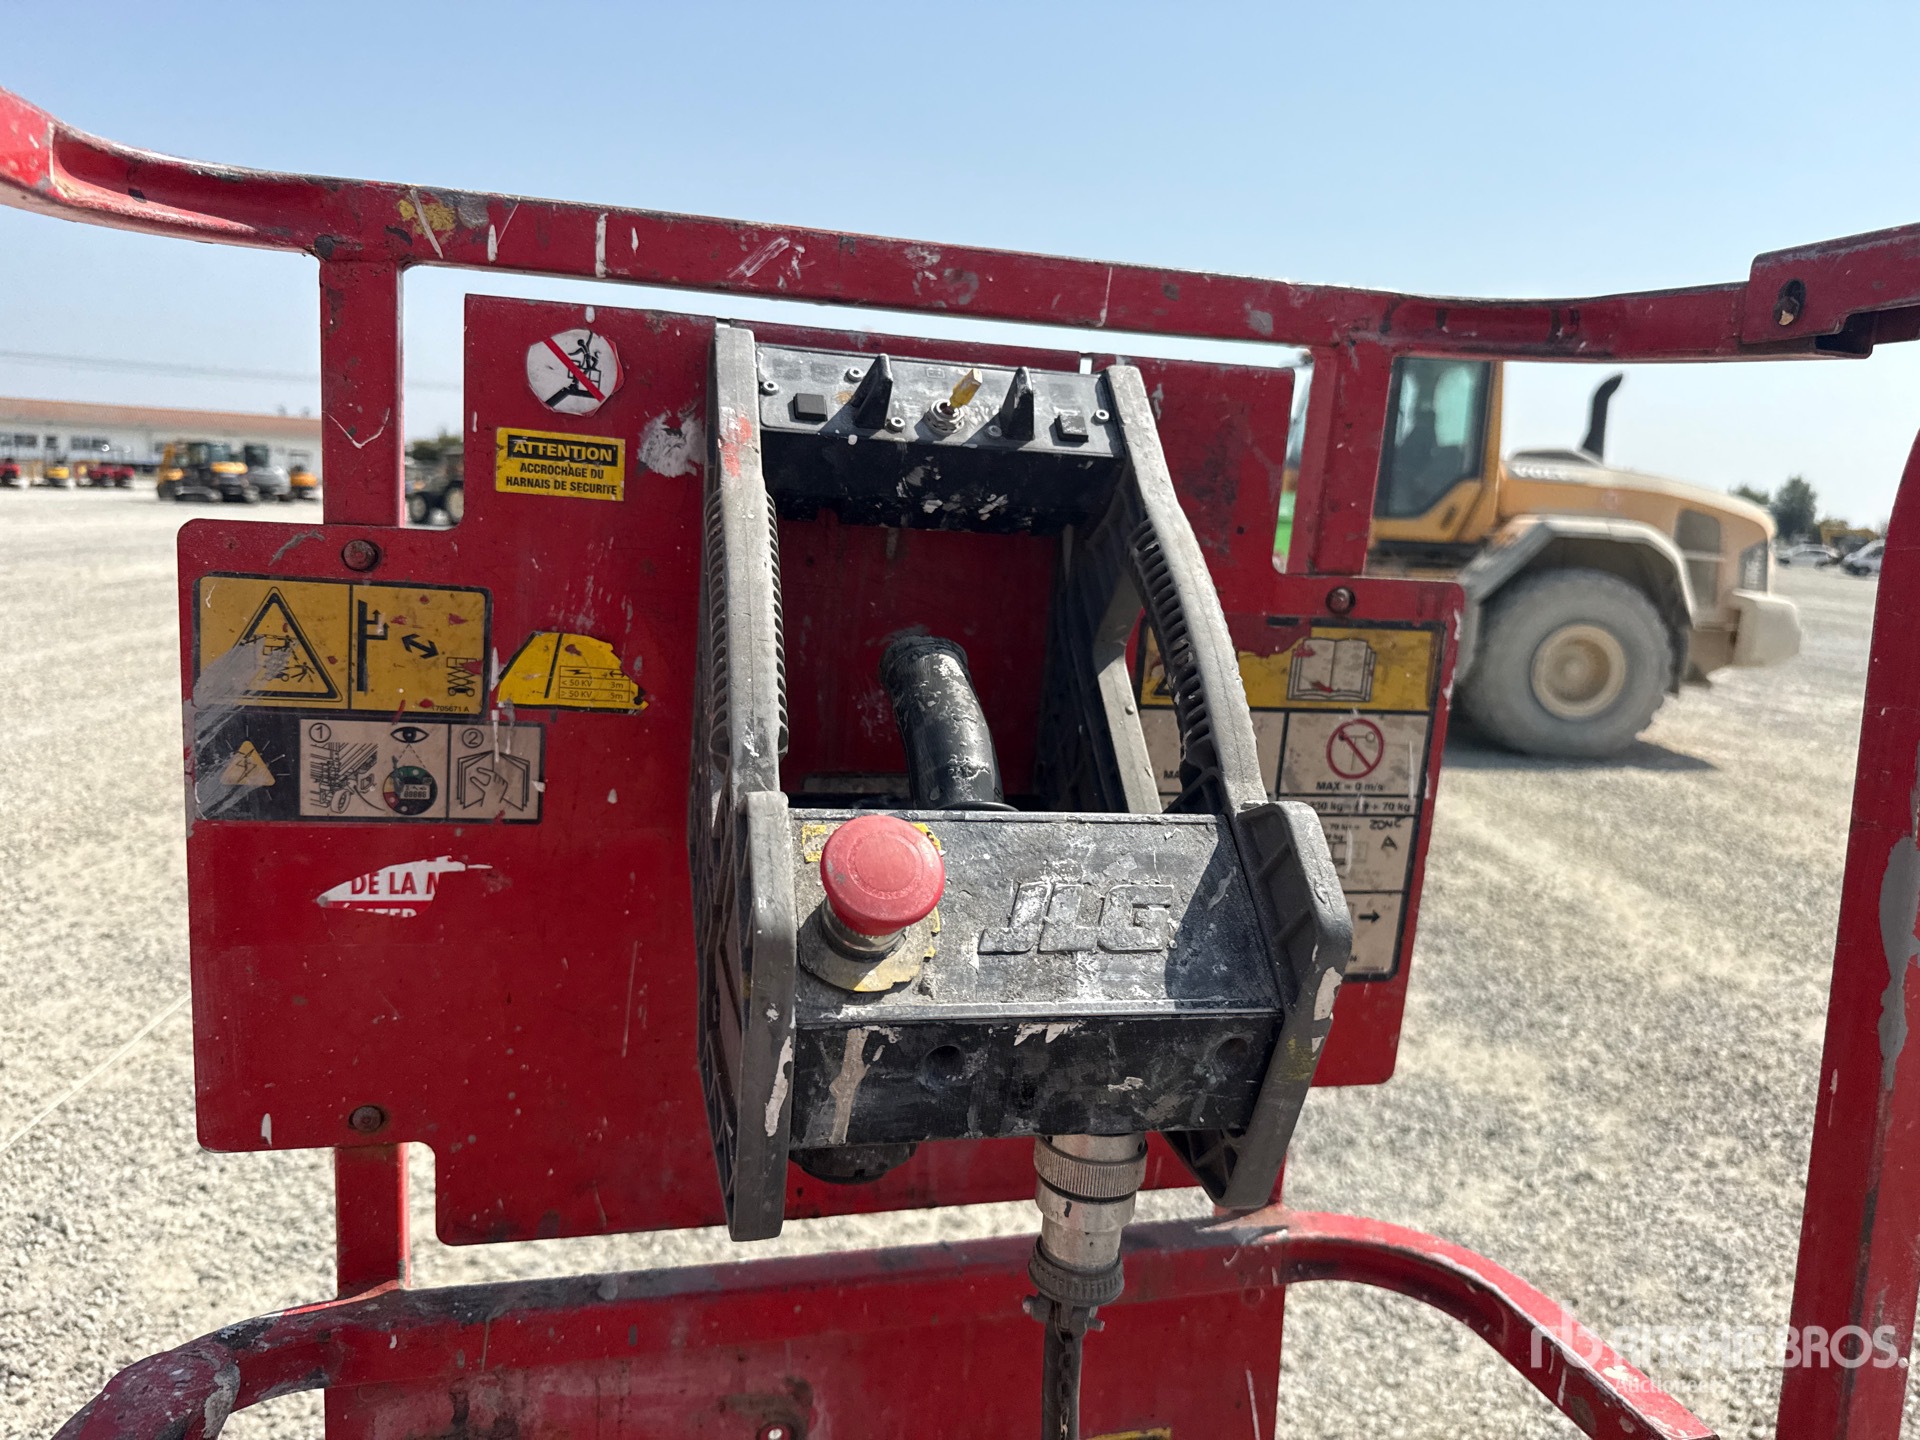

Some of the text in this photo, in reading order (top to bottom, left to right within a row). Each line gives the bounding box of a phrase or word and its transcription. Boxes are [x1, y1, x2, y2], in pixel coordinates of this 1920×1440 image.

[513, 440, 613, 462] ATTENTION
[520, 462, 604, 480] ACCROCHAGE DU
[506, 476, 618, 495] HARNAIS DE SECURITE
[569, 679, 580, 688] 50
[581, 679, 593, 688] KV
[610, 681, 624, 689] 3m
[569, 690, 580, 699] 50
[581, 690, 593, 699] KV
[610, 691, 624, 700] 5m
[463, 705, 470, 713] A
[1163, 769, 1180, 779] MA
[1315, 781, 1341, 791] MAX
[1382, 802, 1395, 811] 70
[1397, 802, 1411, 812] kg
[1381, 835, 1398, 851] A
[351, 871, 380, 895] DE
[390, 871, 418, 895] LA
[977, 882, 1175, 954] JLG
